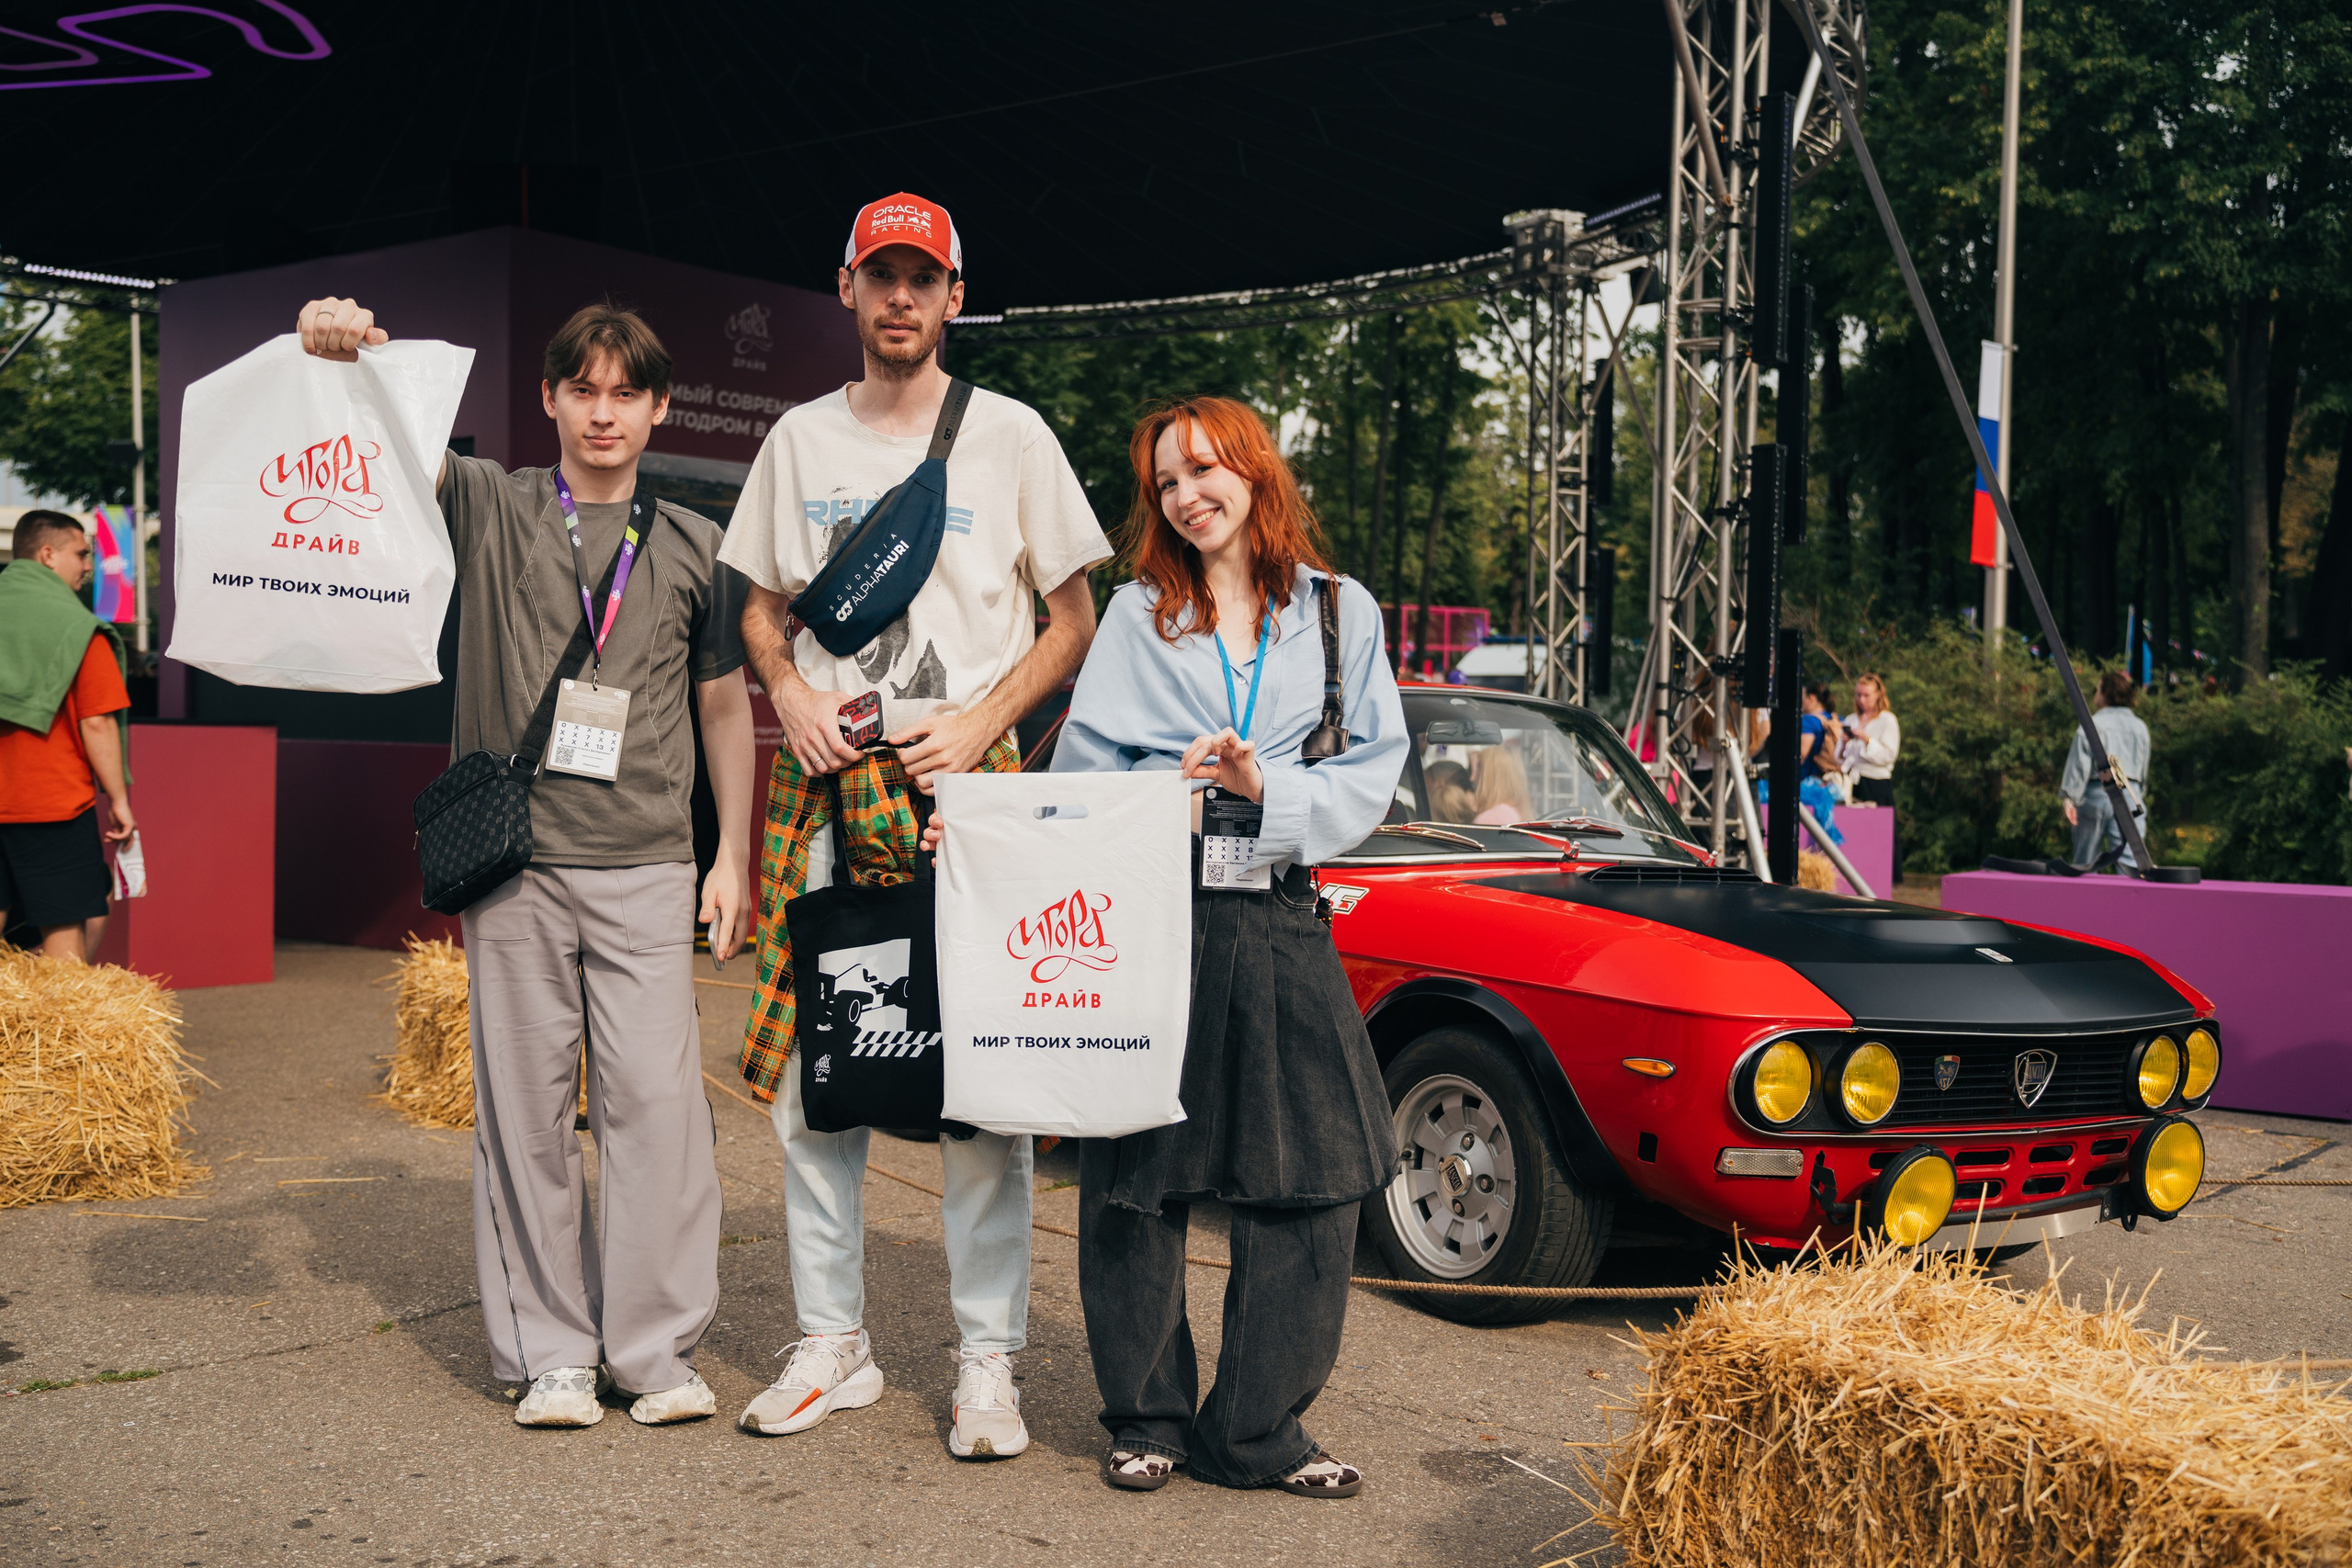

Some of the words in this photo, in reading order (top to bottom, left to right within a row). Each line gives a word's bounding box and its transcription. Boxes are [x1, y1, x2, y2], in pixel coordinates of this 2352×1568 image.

[871, 215, 887, 228] Red
[888, 214, 904, 223] Bull
[873, 204, 932, 221] ORACLE
[870, 225, 933, 239] RACING
[271, 532, 360, 556] ДРАЙВ
[829, 533, 898, 611] SCUDERIA
[851, 539, 910, 606] ALPHATAURI
[212, 572, 254, 588] МИР
[259, 577, 322, 595] ТВОИХ
[327, 584, 411, 604] ЭМОЦИЙ
[1022, 989, 1102, 1009] ДРАЙВ
[973, 1036, 1011, 1048] МИР
[1014, 1036, 1071, 1049] ТВОИХ
[1076, 1035, 1150, 1052] ЭМОЦИЙ
